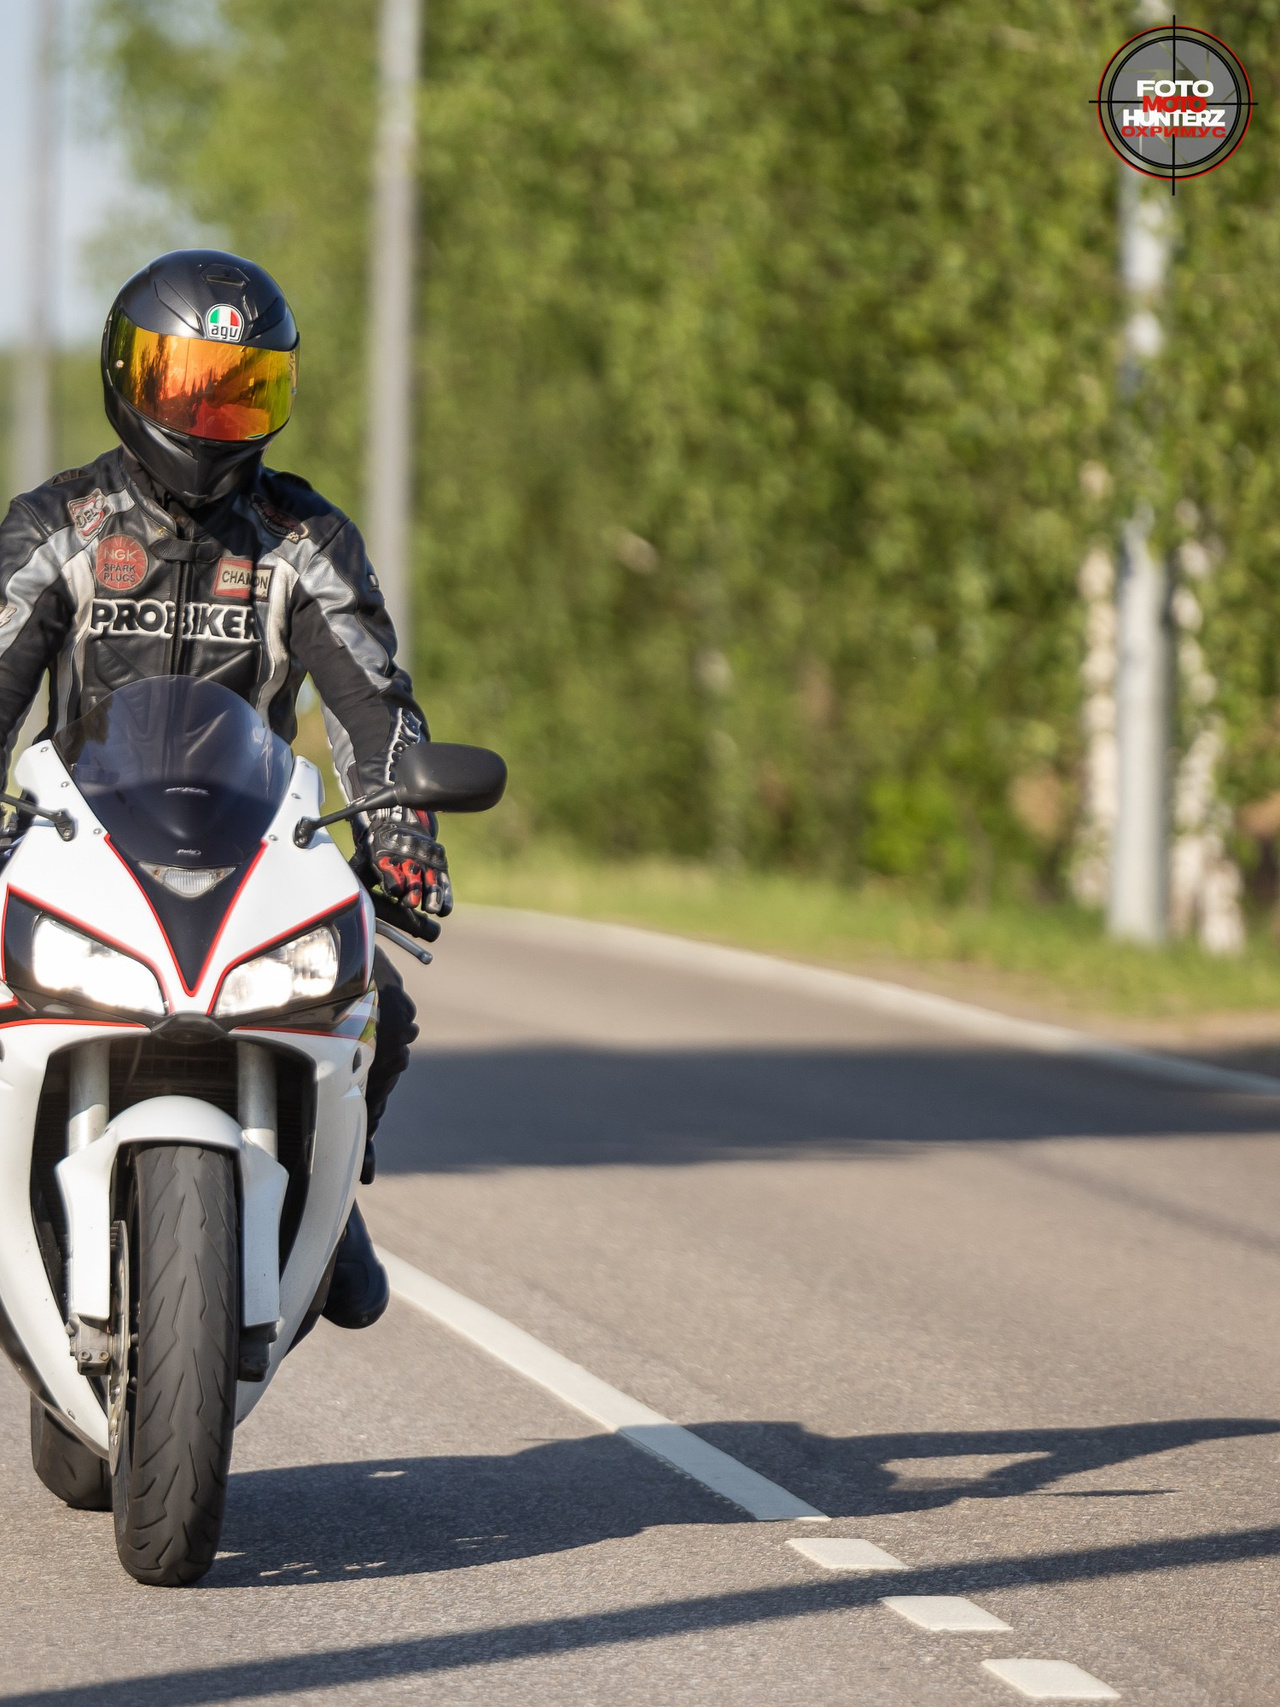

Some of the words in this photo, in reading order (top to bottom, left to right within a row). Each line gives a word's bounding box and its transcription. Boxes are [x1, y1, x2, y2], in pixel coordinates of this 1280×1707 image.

[211, 325, 238, 340] agv
[103, 547, 141, 562] NGK
[103, 563, 136, 574] SPARK
[103, 572, 136, 583] PLUGS
